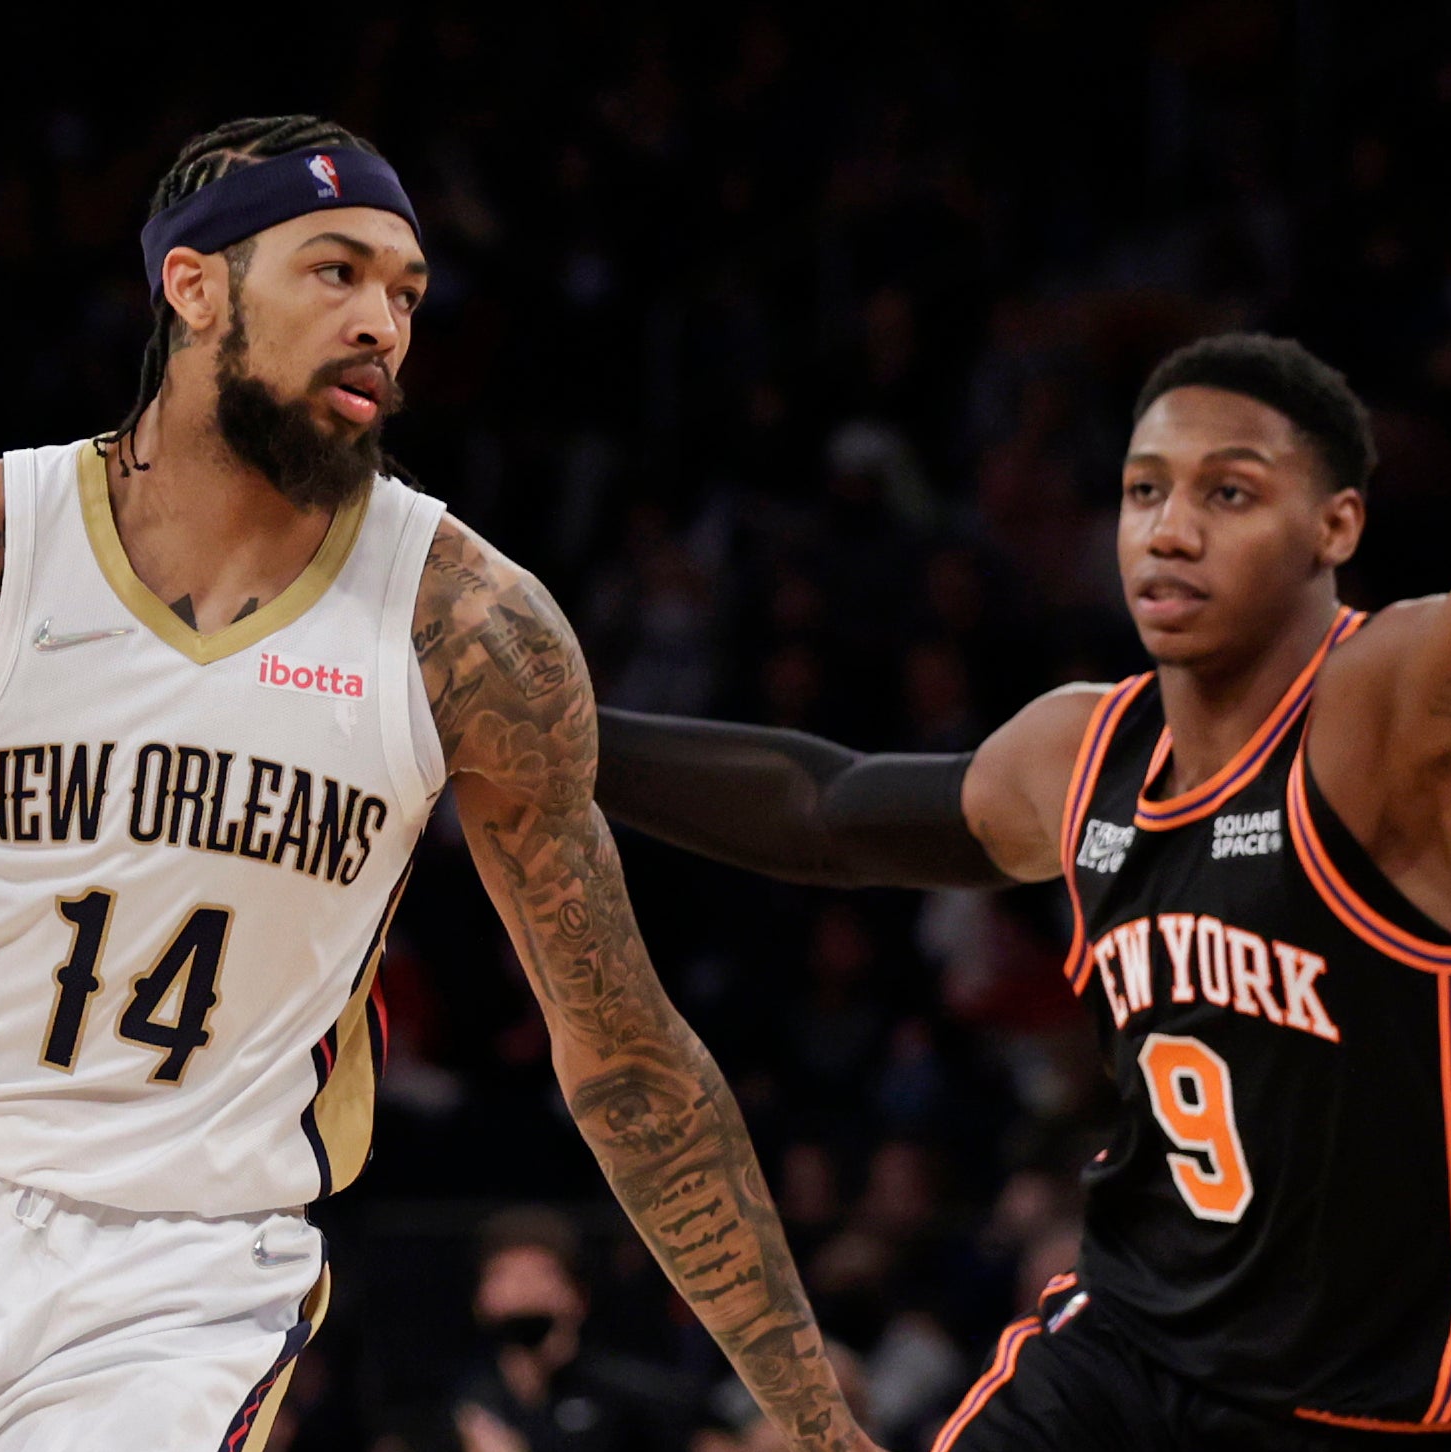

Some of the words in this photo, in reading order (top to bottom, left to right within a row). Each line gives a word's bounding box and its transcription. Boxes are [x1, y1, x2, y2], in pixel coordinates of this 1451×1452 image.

[258, 653, 364, 698] ibotta
[129, 743, 388, 886] ORLEANS
[1211, 832, 1269, 860] SPACE
[38, 886, 235, 1088] 14
[1093, 917, 1154, 1031] EW
[1156, 912, 1342, 1045] YORK
[1137, 1032, 1255, 1225] 9
